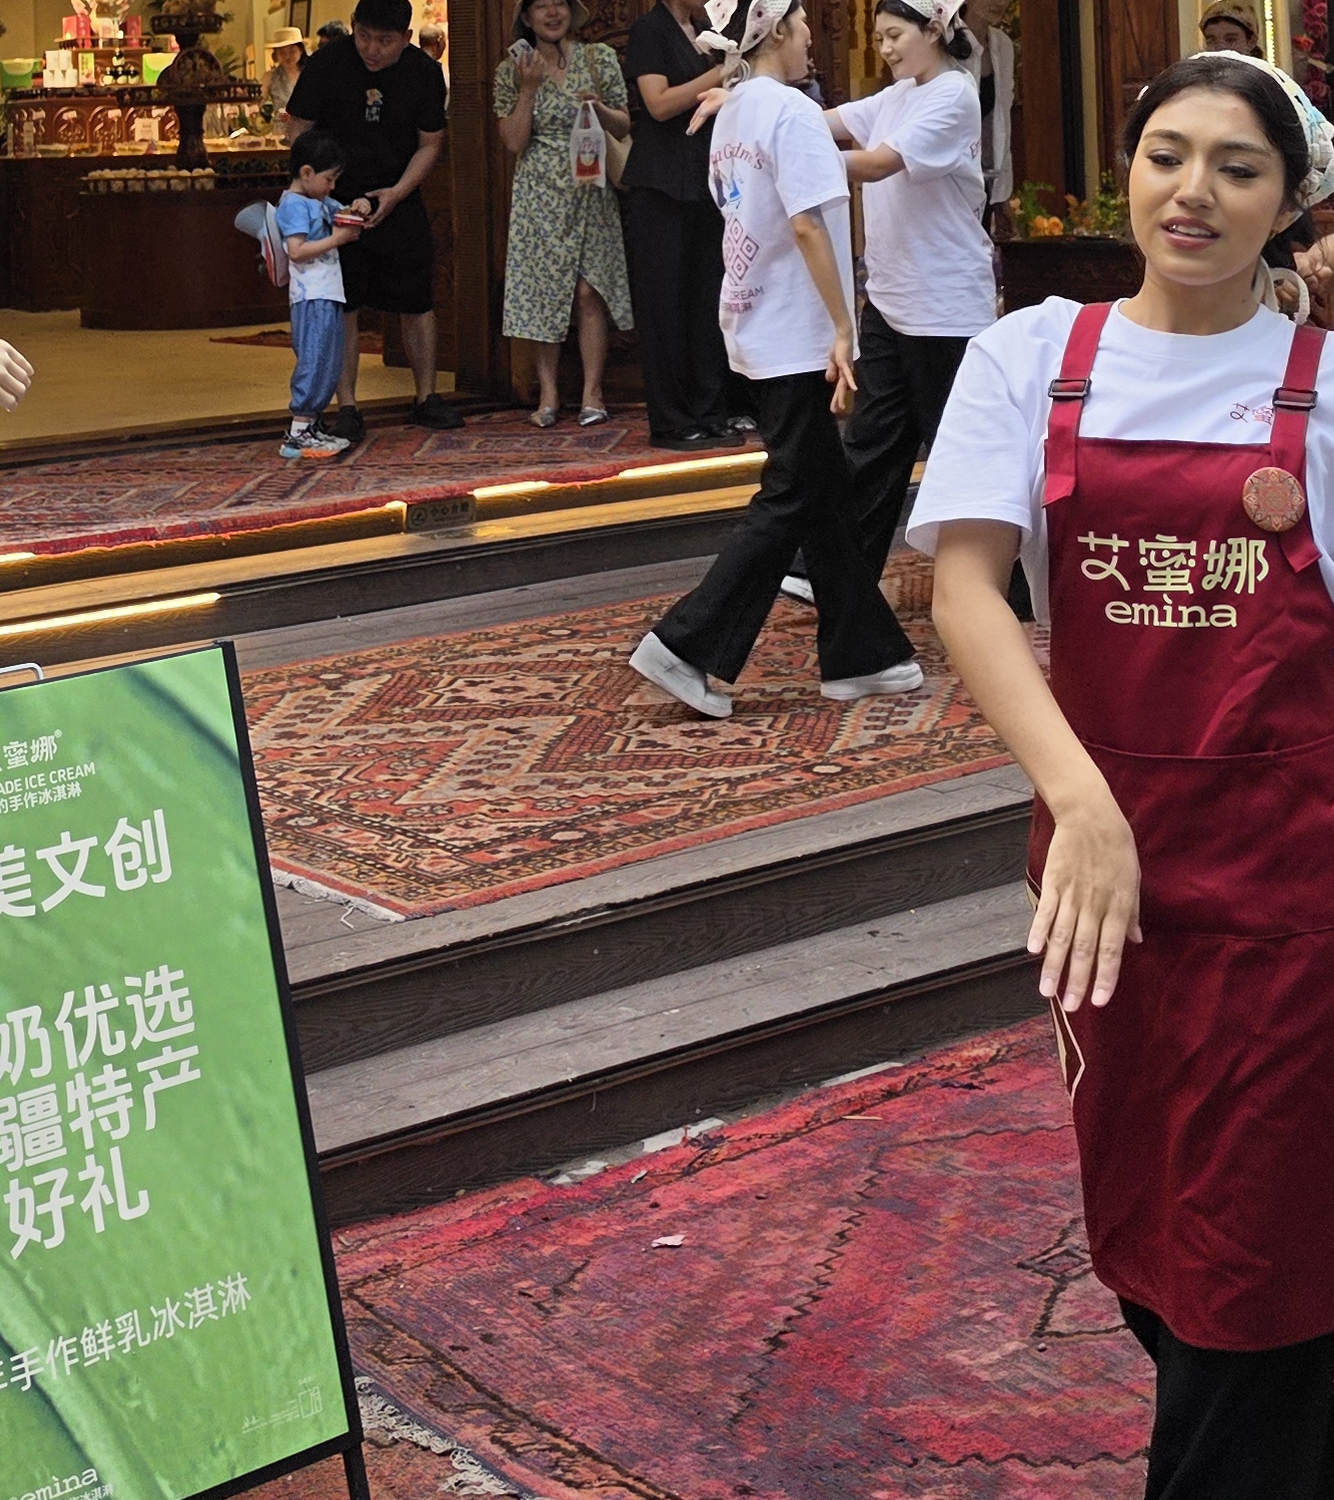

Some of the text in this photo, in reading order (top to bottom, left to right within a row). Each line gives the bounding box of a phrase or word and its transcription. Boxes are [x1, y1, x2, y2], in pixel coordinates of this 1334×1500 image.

[1077, 531, 1269, 595] 艾蜜娜
[1105, 594, 1237, 628] emina
[24, 773, 46, 791] ICE
[49, 762, 96, 784] CREAM
[4, 1147, 150, 1260] 好礼
